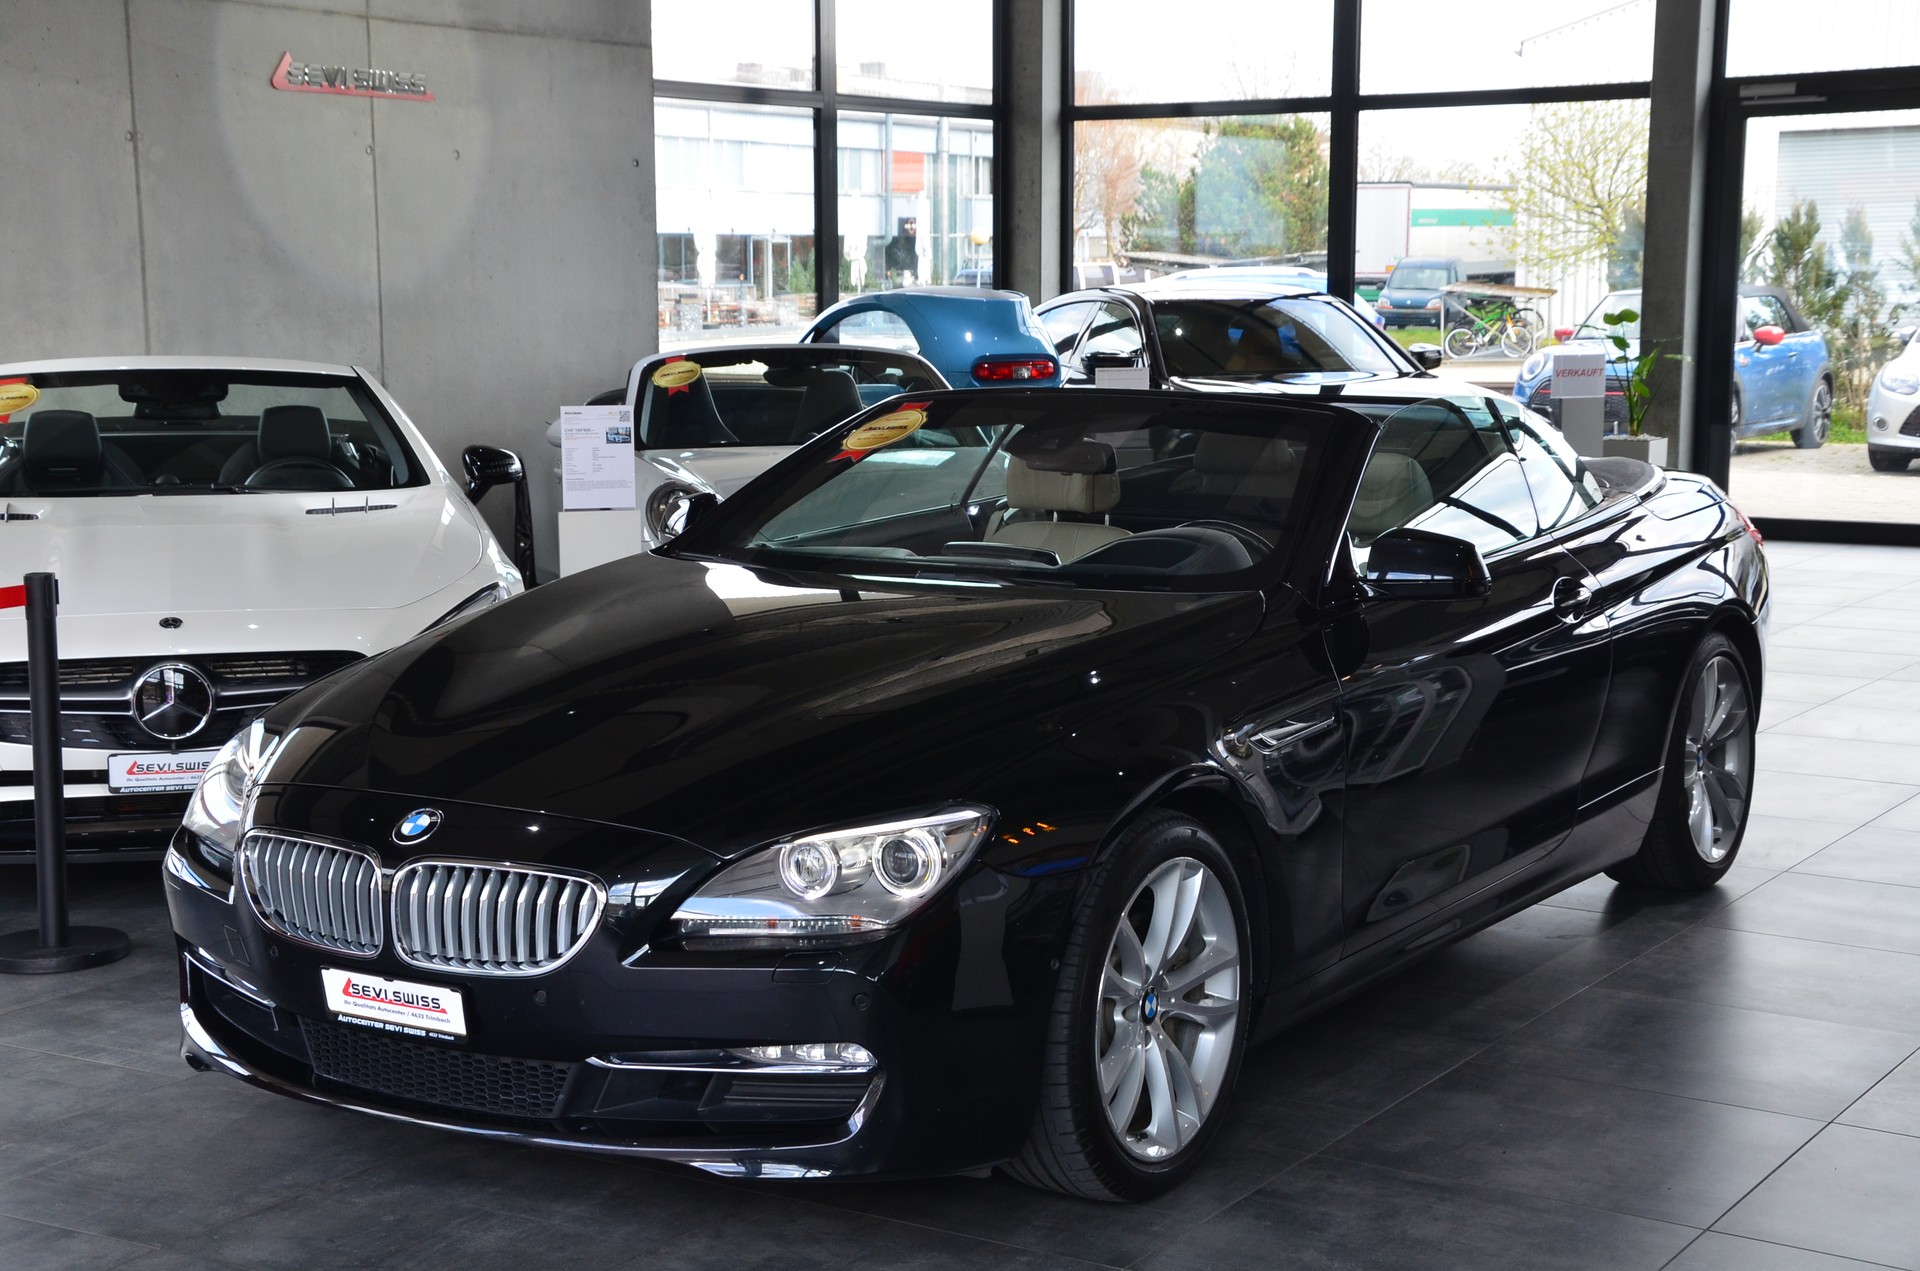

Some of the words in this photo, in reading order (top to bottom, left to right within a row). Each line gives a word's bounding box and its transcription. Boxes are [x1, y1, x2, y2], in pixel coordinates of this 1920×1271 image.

[288, 61, 349, 90] SEVI
[354, 68, 427, 96] SWISS
[1556, 368, 1604, 377] VERKAUFT
[136, 763, 170, 772] SEVI
[176, 762, 210, 771] SWIS
[351, 984, 388, 1000] SEVI
[393, 991, 441, 1009] SWISS
[378, 1006, 406, 1015] Autocenter
[426, 1014, 450, 1023] Trimbach
[385, 1024, 402, 1032] SEVI
[403, 1027, 426, 1036] SWISS
